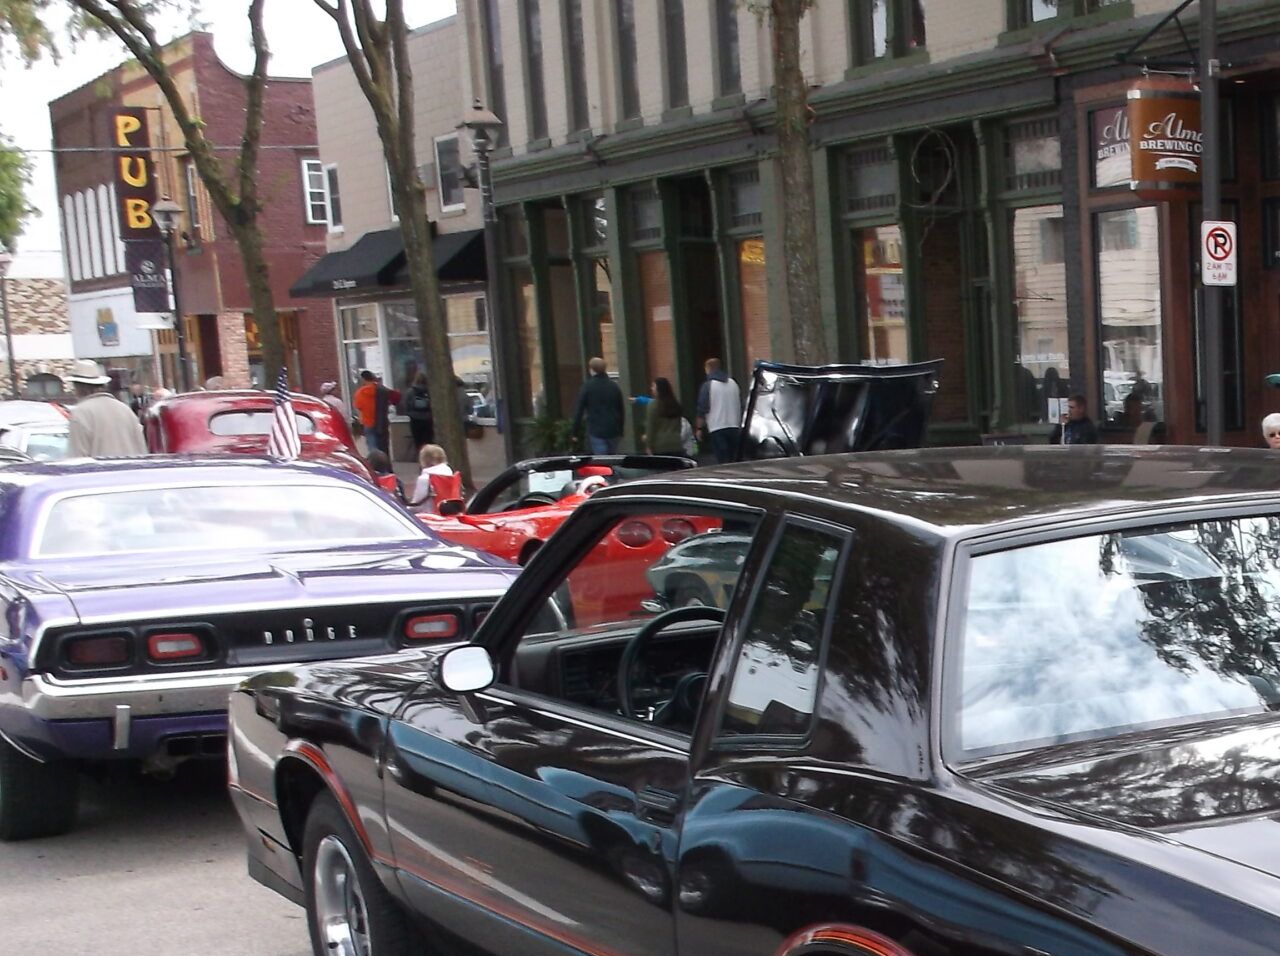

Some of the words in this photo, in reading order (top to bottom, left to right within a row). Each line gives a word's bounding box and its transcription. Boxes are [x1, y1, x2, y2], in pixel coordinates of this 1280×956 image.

[1140, 139, 1194, 153] BREWING
[115, 114, 152, 229] PUB
[264, 625, 357, 645] DODGE
